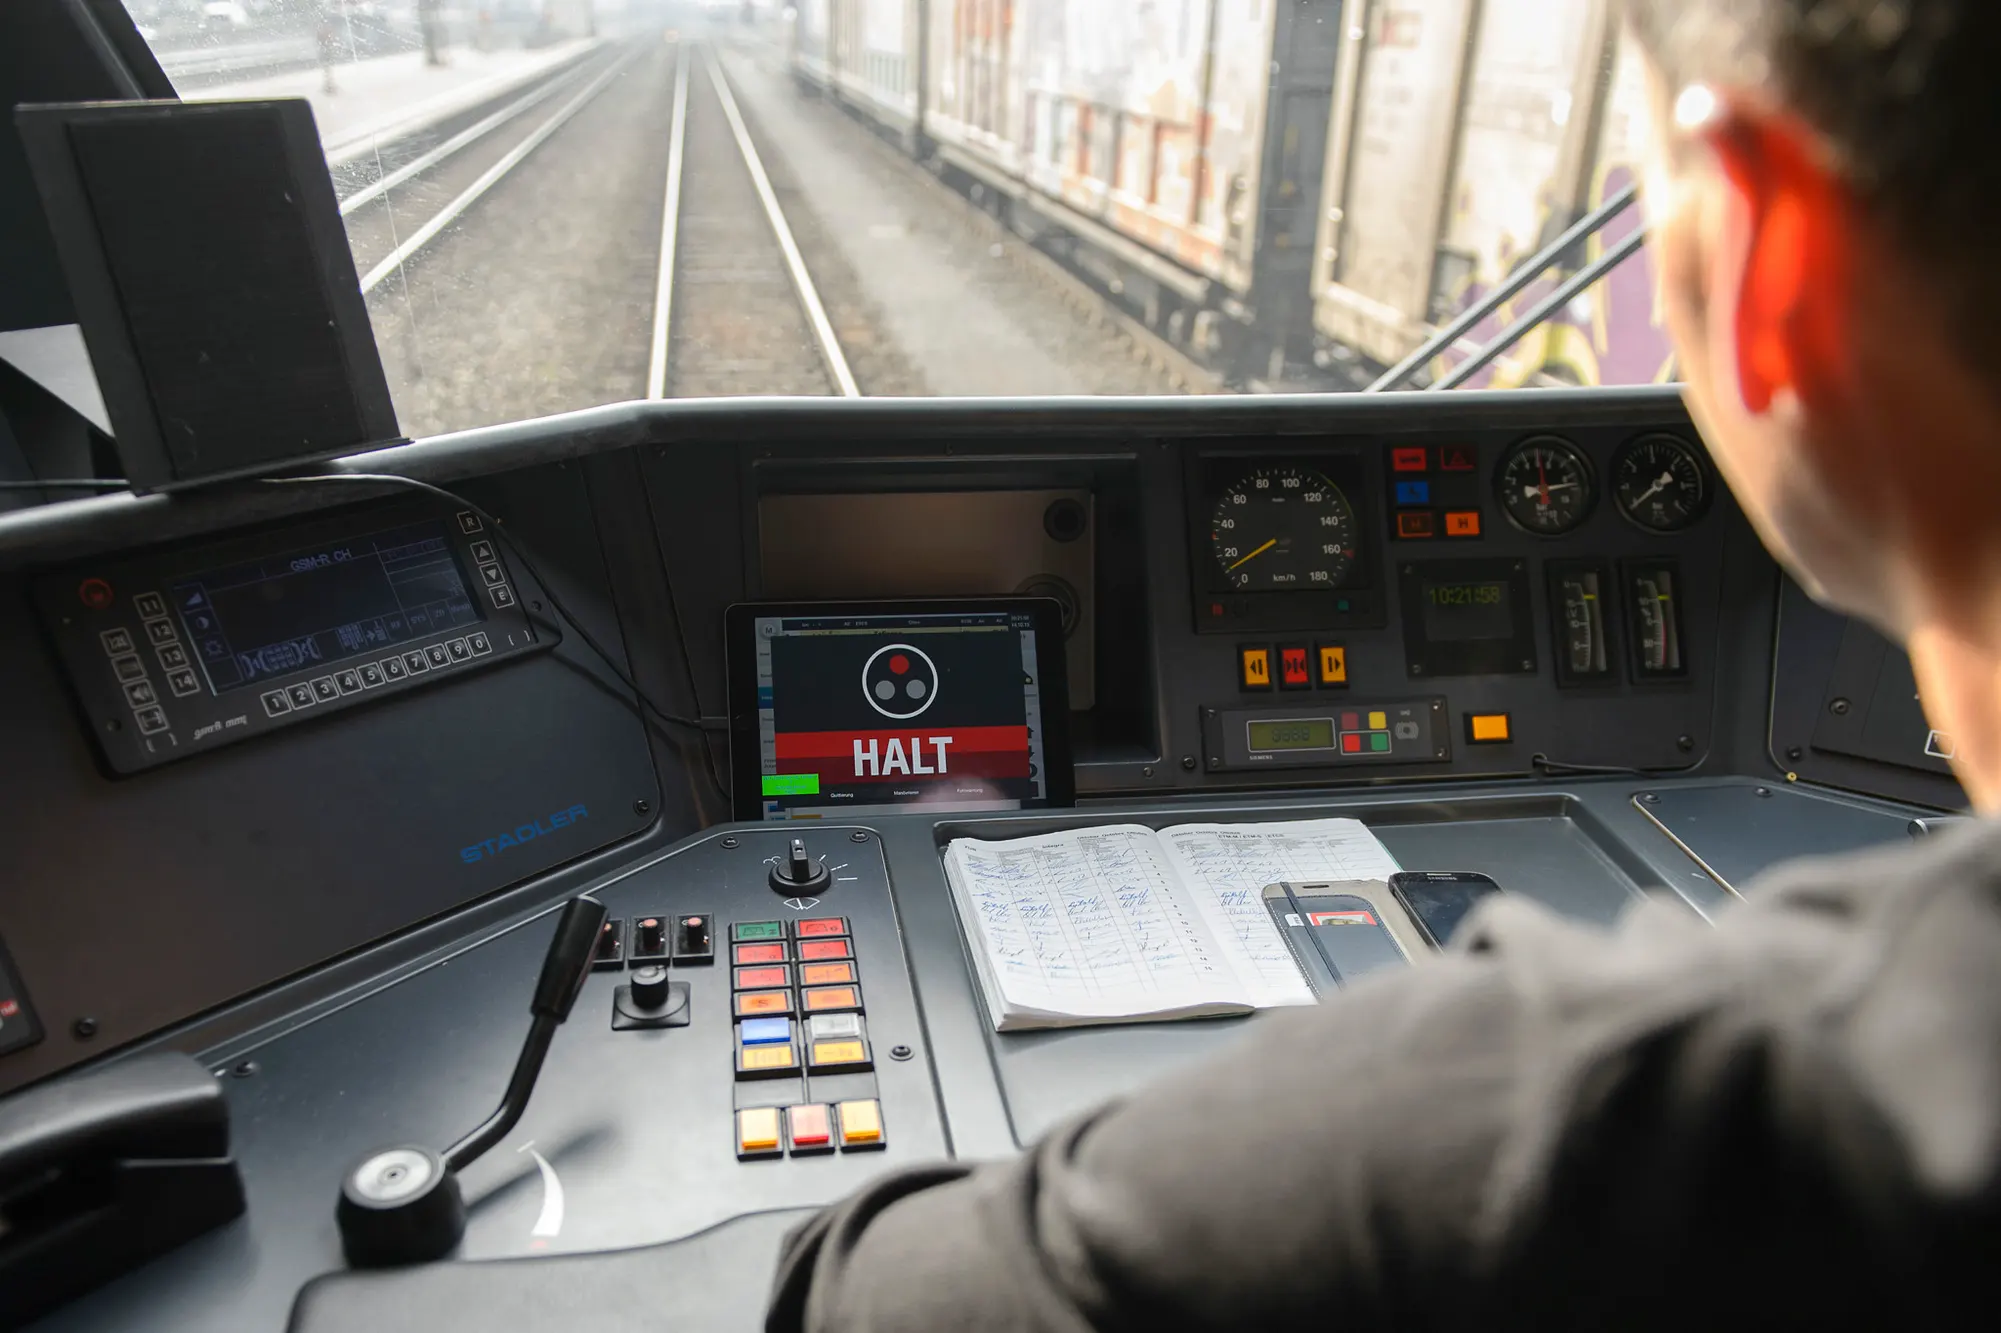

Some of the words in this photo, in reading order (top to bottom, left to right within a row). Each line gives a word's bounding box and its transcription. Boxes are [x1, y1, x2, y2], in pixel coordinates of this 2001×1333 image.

[1256, 479, 1269, 488] 80
[1281, 478, 1300, 488] 100
[1233, 494, 1247, 504] 60
[1303, 492, 1322, 502] 120
[465, 517, 475, 527] R
[1221, 519, 1235, 529] 40
[1320, 516, 1339, 526] 140
[1224, 547, 1238, 557] 20
[1322, 544, 1341, 554] 160
[289, 553, 331, 573] GSM-R
[333, 548, 352, 562] CH
[1241, 574, 1248, 583] 0
[1273, 573, 1296, 583] km/h
[1309, 571, 1328, 581] 180
[497, 590, 507, 602] E
[1428, 586, 1501, 605] 10:21:58
[154, 623, 171, 638] 12
[764, 625, 773, 635] M
[475, 639, 484, 650] 0
[454, 645, 463, 656] 9
[164, 650, 182, 663] 13
[433, 651, 442, 662] 8
[411, 657, 420, 668] 7
[389, 663, 398, 674] 6
[366, 670, 376, 681] 5
[174, 675, 194, 690] 14
[344, 676, 354, 688] 4
[320, 683, 331, 694] 3
[296, 690, 307, 702] 2
[272, 697, 280, 709] 1
[853, 736, 953, 777] HALT
[460, 803, 589, 864] STADLER
